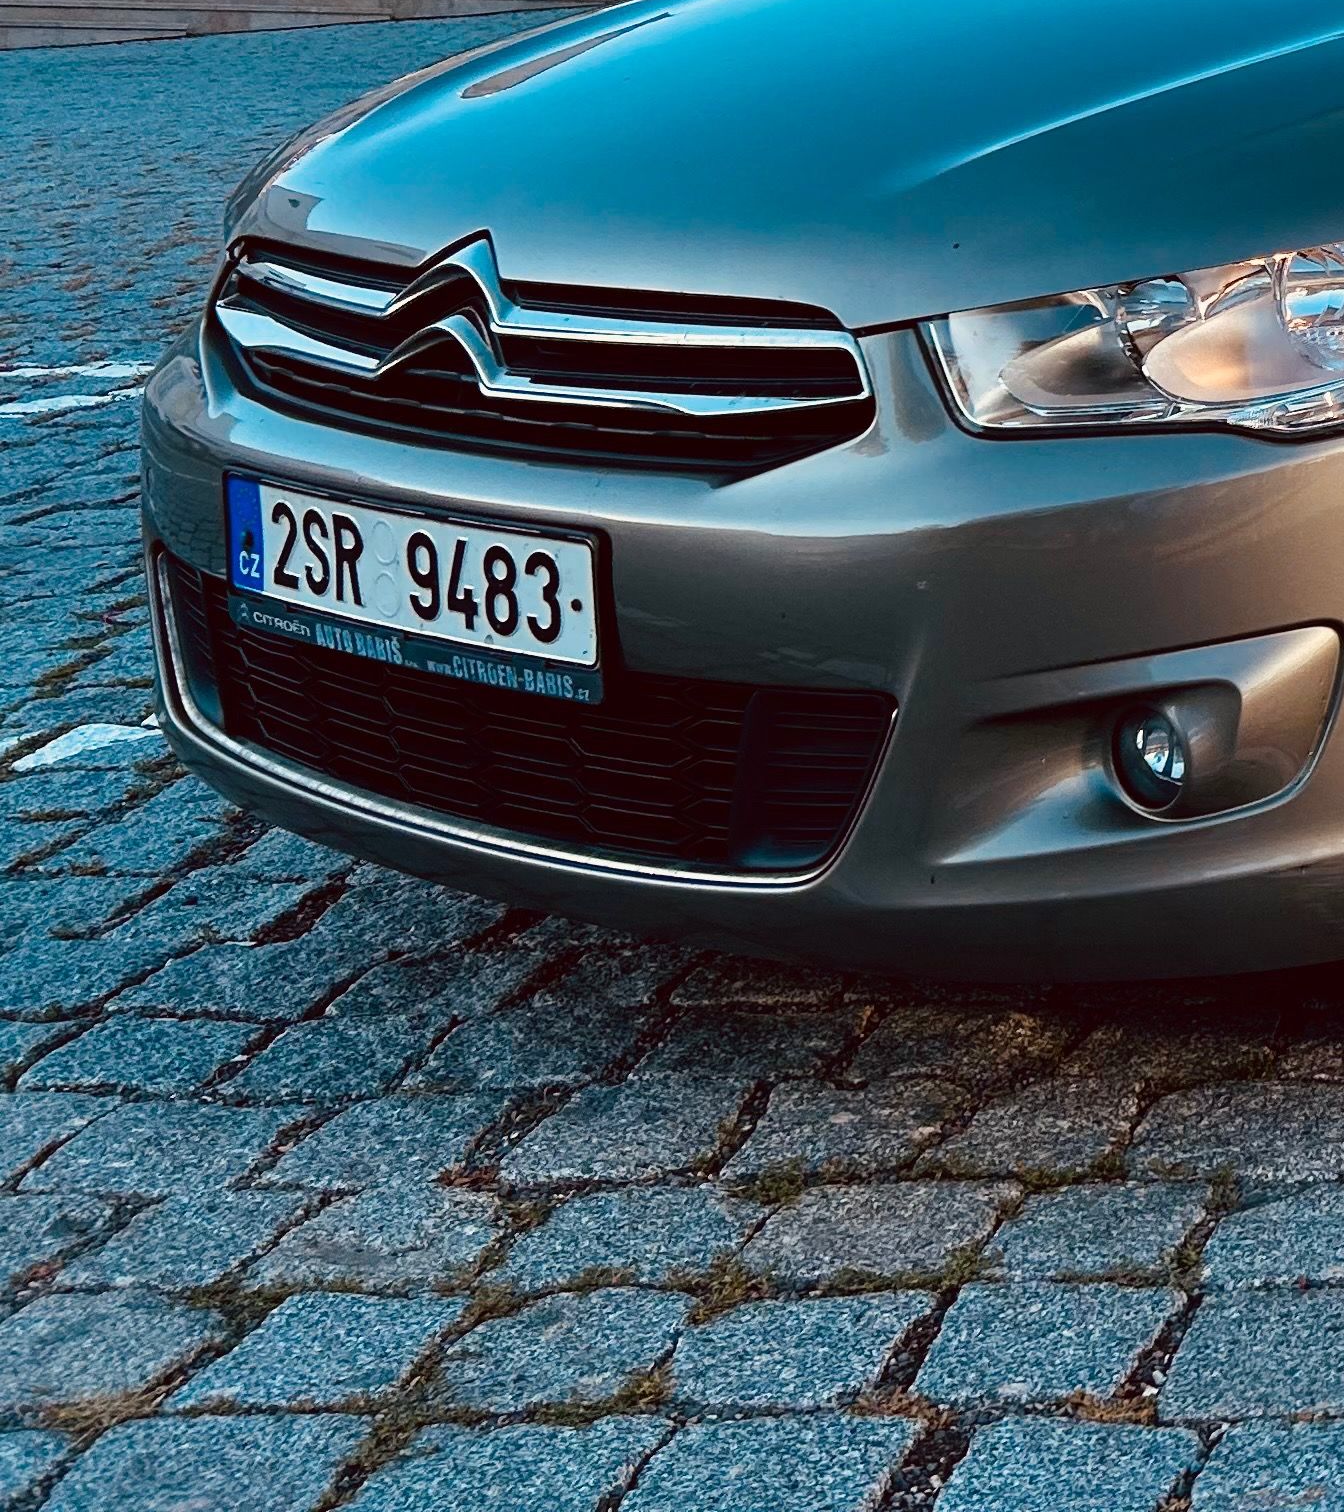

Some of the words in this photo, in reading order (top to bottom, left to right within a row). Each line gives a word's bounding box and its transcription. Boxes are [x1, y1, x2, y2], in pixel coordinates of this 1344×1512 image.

[239, 549, 261, 580] CZ
[271, 498, 367, 608] 2SR
[405, 530, 563, 646] 9483
[315, 623, 353, 654] AUTO
